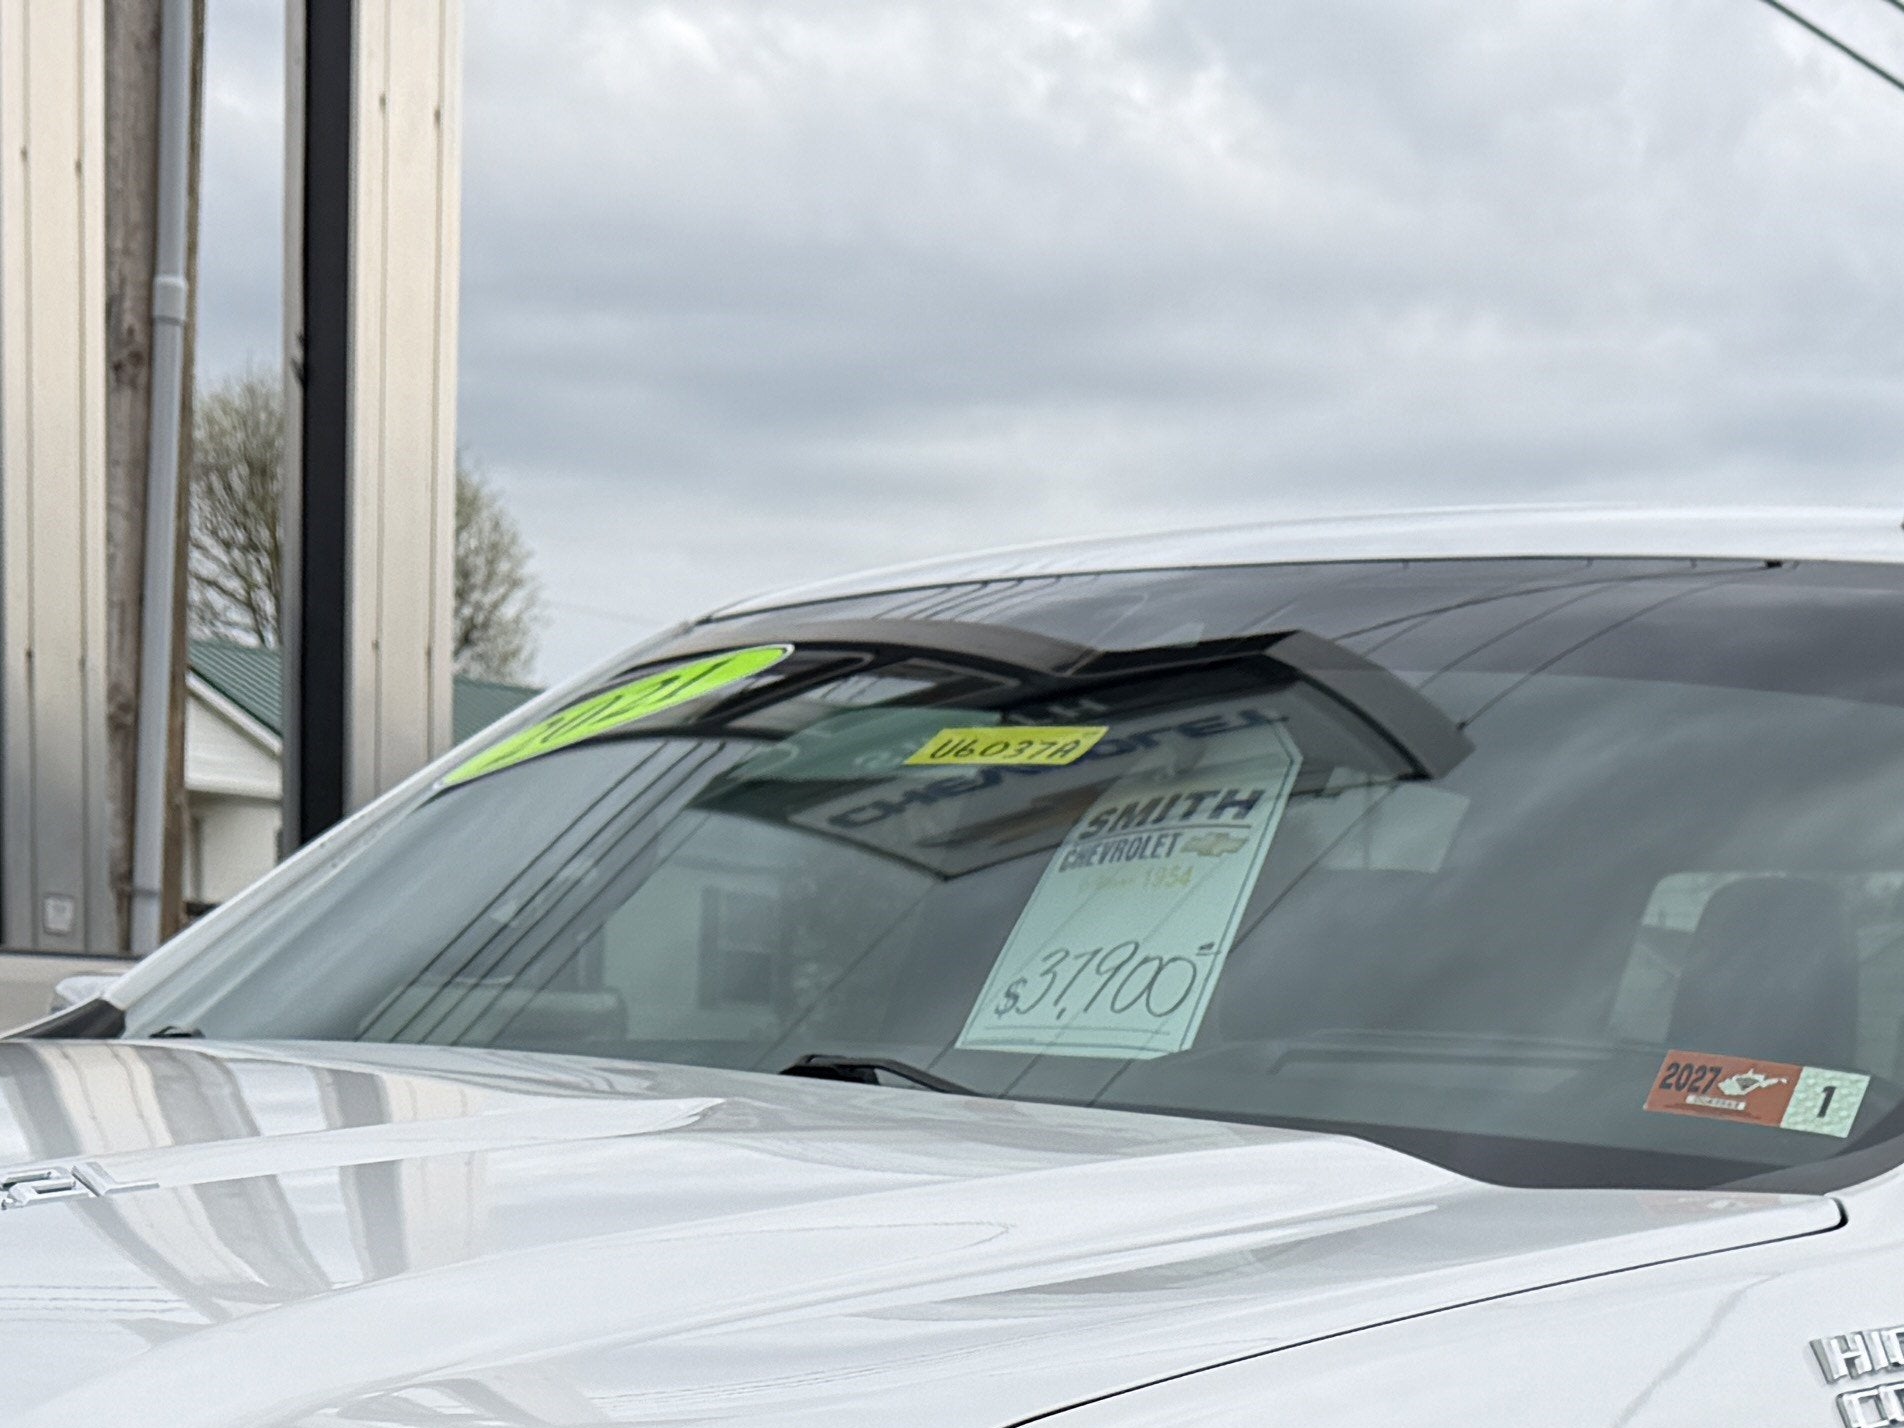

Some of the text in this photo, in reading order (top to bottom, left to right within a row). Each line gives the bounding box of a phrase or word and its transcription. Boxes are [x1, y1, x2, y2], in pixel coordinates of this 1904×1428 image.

[929, 738, 1081, 761] U6037A
[1079, 788, 1265, 840] SMITH
[1058, 832, 1184, 873] CHEVROLET
[994, 940, 1198, 1019] $37,900
[1658, 1062, 1838, 1118] 2027 1
